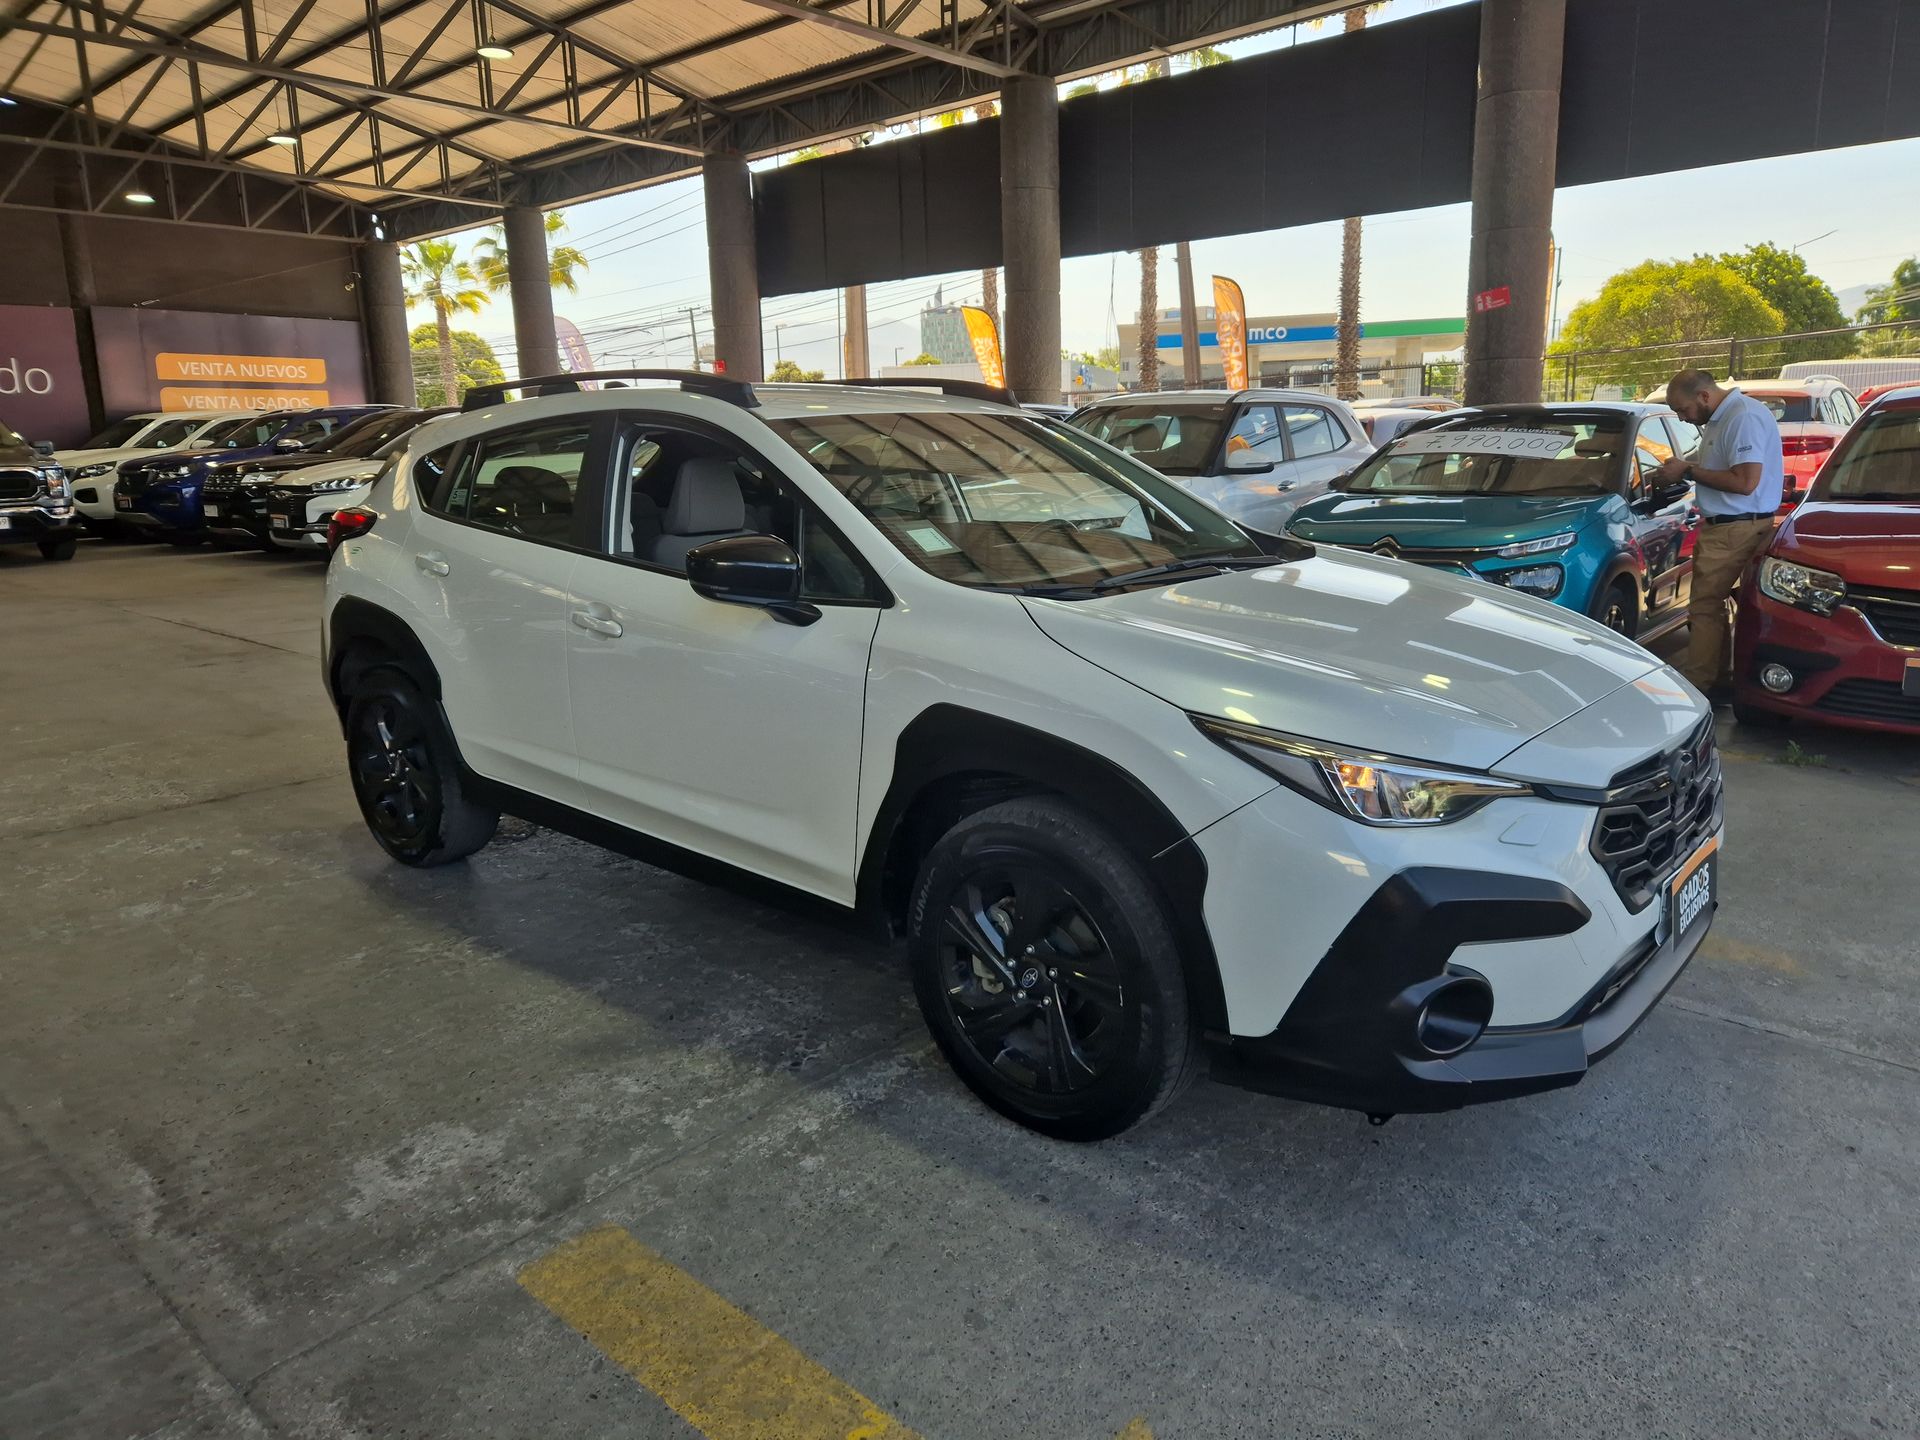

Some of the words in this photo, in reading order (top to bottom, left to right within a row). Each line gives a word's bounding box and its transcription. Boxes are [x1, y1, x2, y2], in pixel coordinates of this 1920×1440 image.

[178, 362, 236, 377] VENTA
[240, 364, 307, 379] NUEVOS
[183, 395, 240, 409] VENTA
[244, 397, 310, 410] USADOS
[1680, 863, 1709, 915] USADOS
[1680, 886, 1709, 934] EXCLUSIVOS
